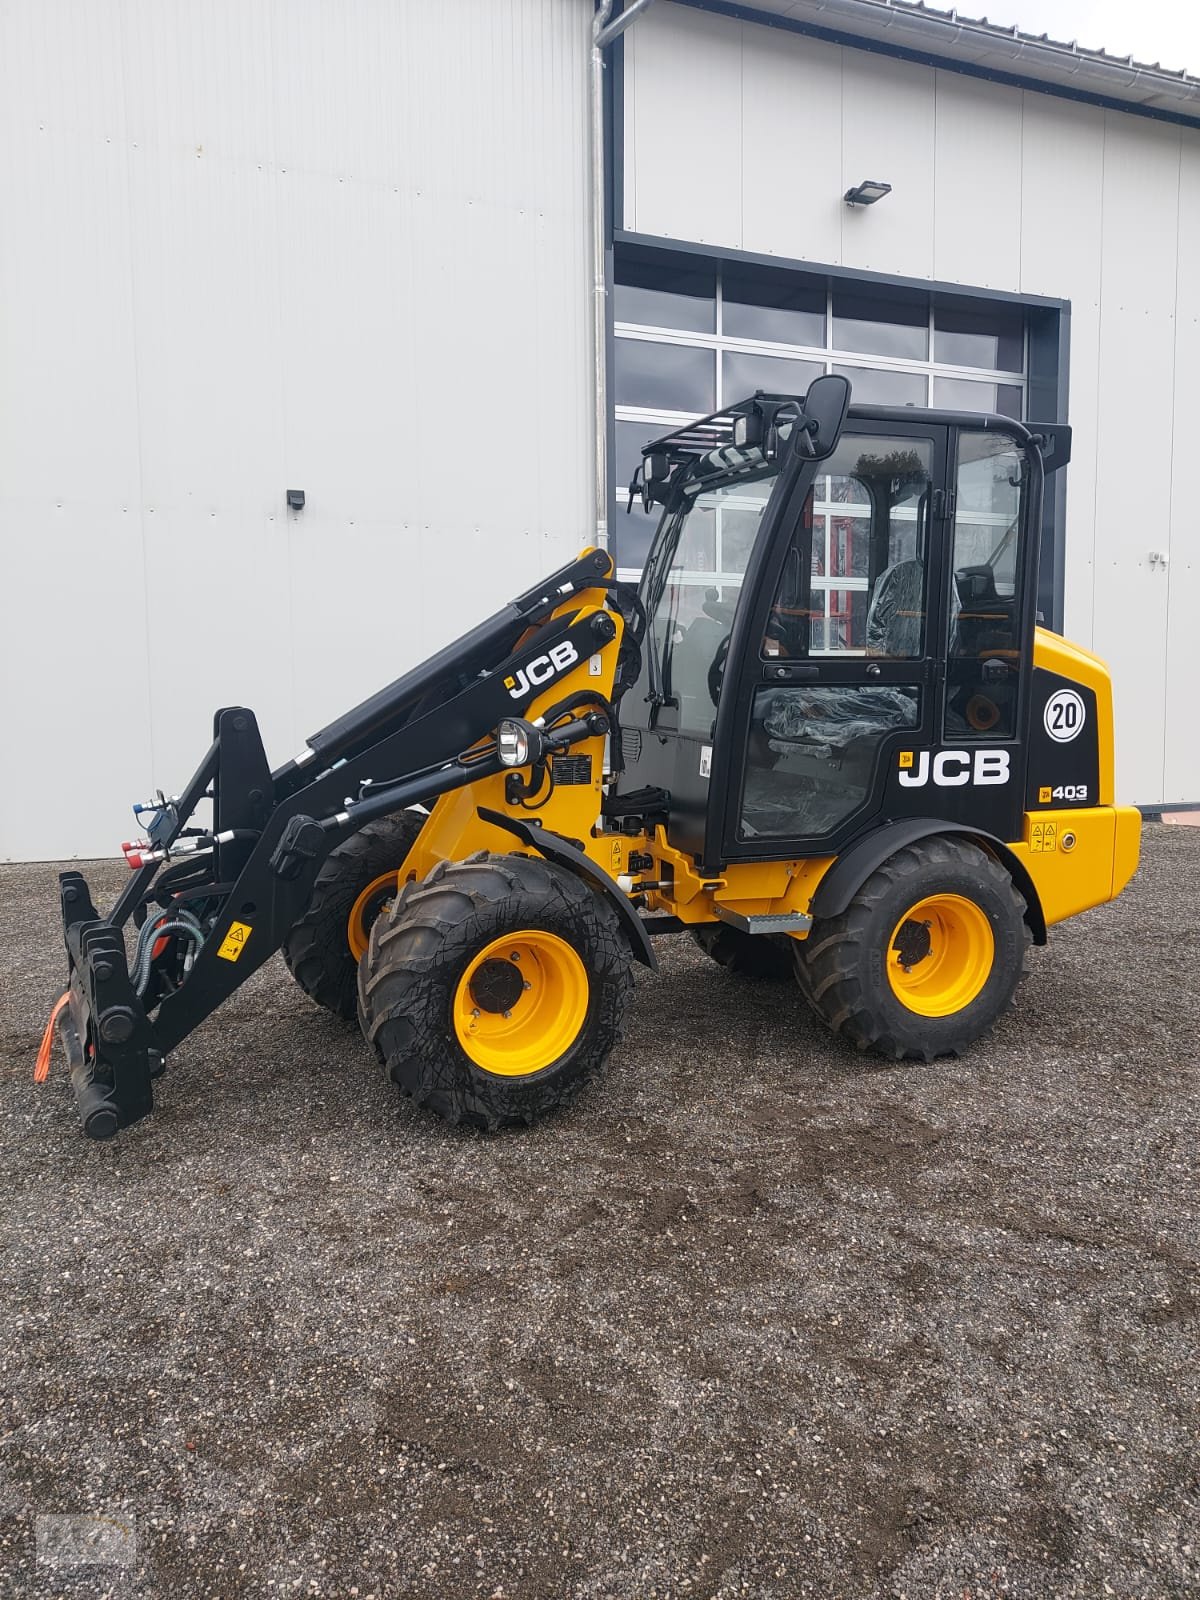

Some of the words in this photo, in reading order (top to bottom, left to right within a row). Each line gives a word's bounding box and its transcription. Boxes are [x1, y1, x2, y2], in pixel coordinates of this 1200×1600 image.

[509, 640, 579, 699] JCB
[1052, 702, 1077, 730] 20
[898, 749, 1010, 787] JCB
[1052, 785, 1088, 799] 403
